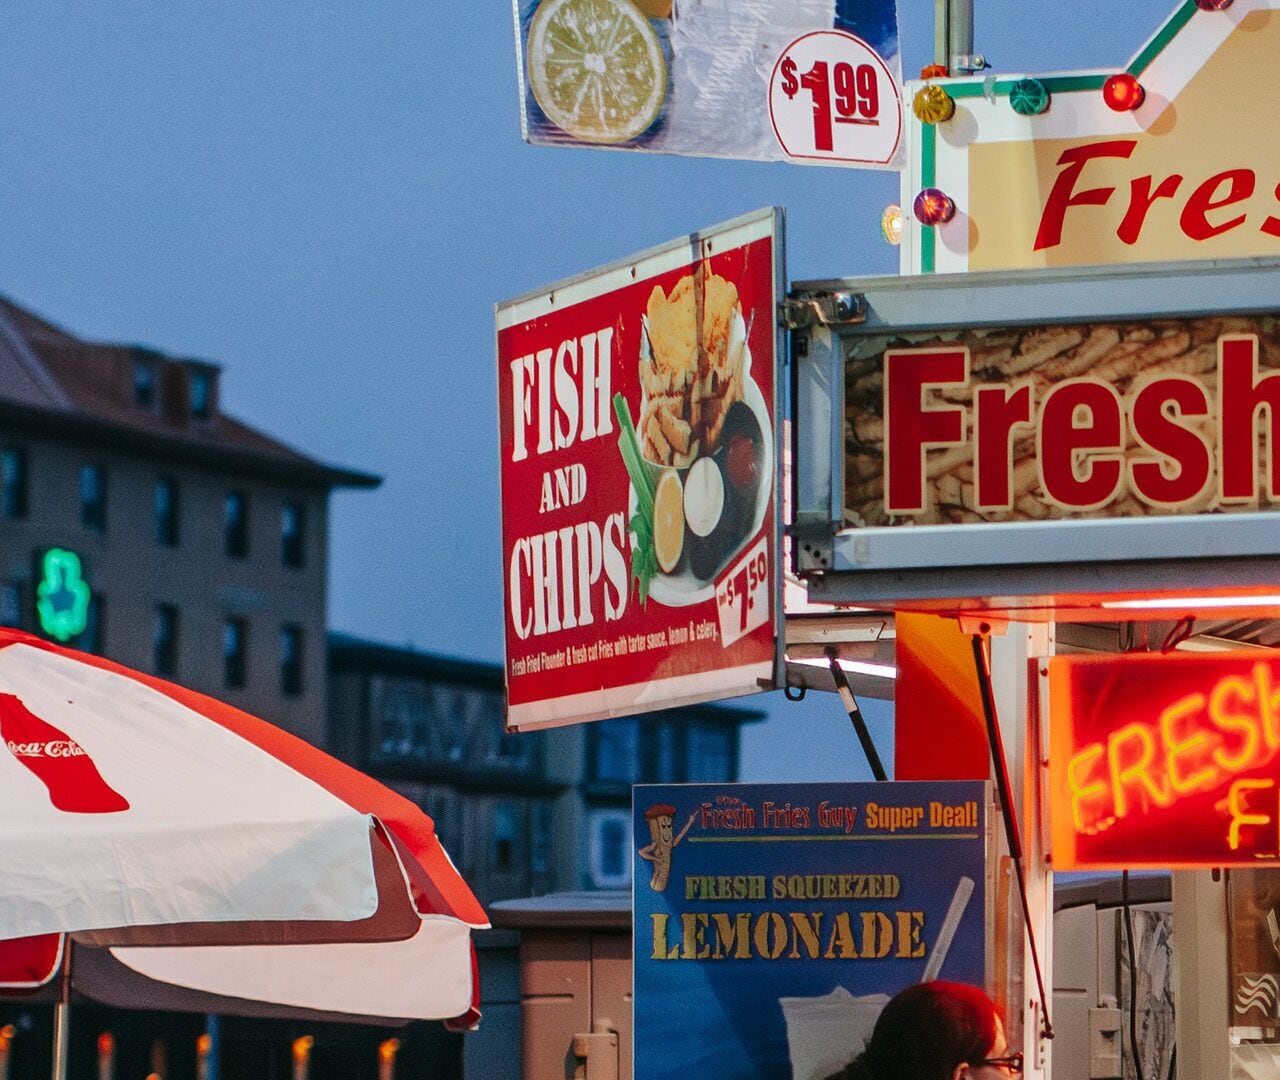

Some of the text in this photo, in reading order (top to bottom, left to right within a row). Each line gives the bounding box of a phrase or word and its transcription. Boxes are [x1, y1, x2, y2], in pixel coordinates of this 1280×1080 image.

[511, 327, 613, 462] FISH
[539, 463, 587, 514] AND
[510, 511, 628, 640] CHIPS
[512, 657, 527, 677] Fresh
[526, 653, 541, 674] Fried
[541, 650, 566, 672] Flounder
[566, 650, 573, 667] &
[572, 645, 588, 665] fresh
[588, 643, 599, 662] cut
[598, 641, 614, 661] Fries
[615, 636, 628, 656] with
[668, 626, 689, 645] lemon
[689, 620, 695, 642] &
[702, 800, 978, 833] Fresh Fries Guy Super Deal!
[685, 873, 900, 900] FRESH SQUEEZED
[649, 910, 927, 961] LEMONADE
